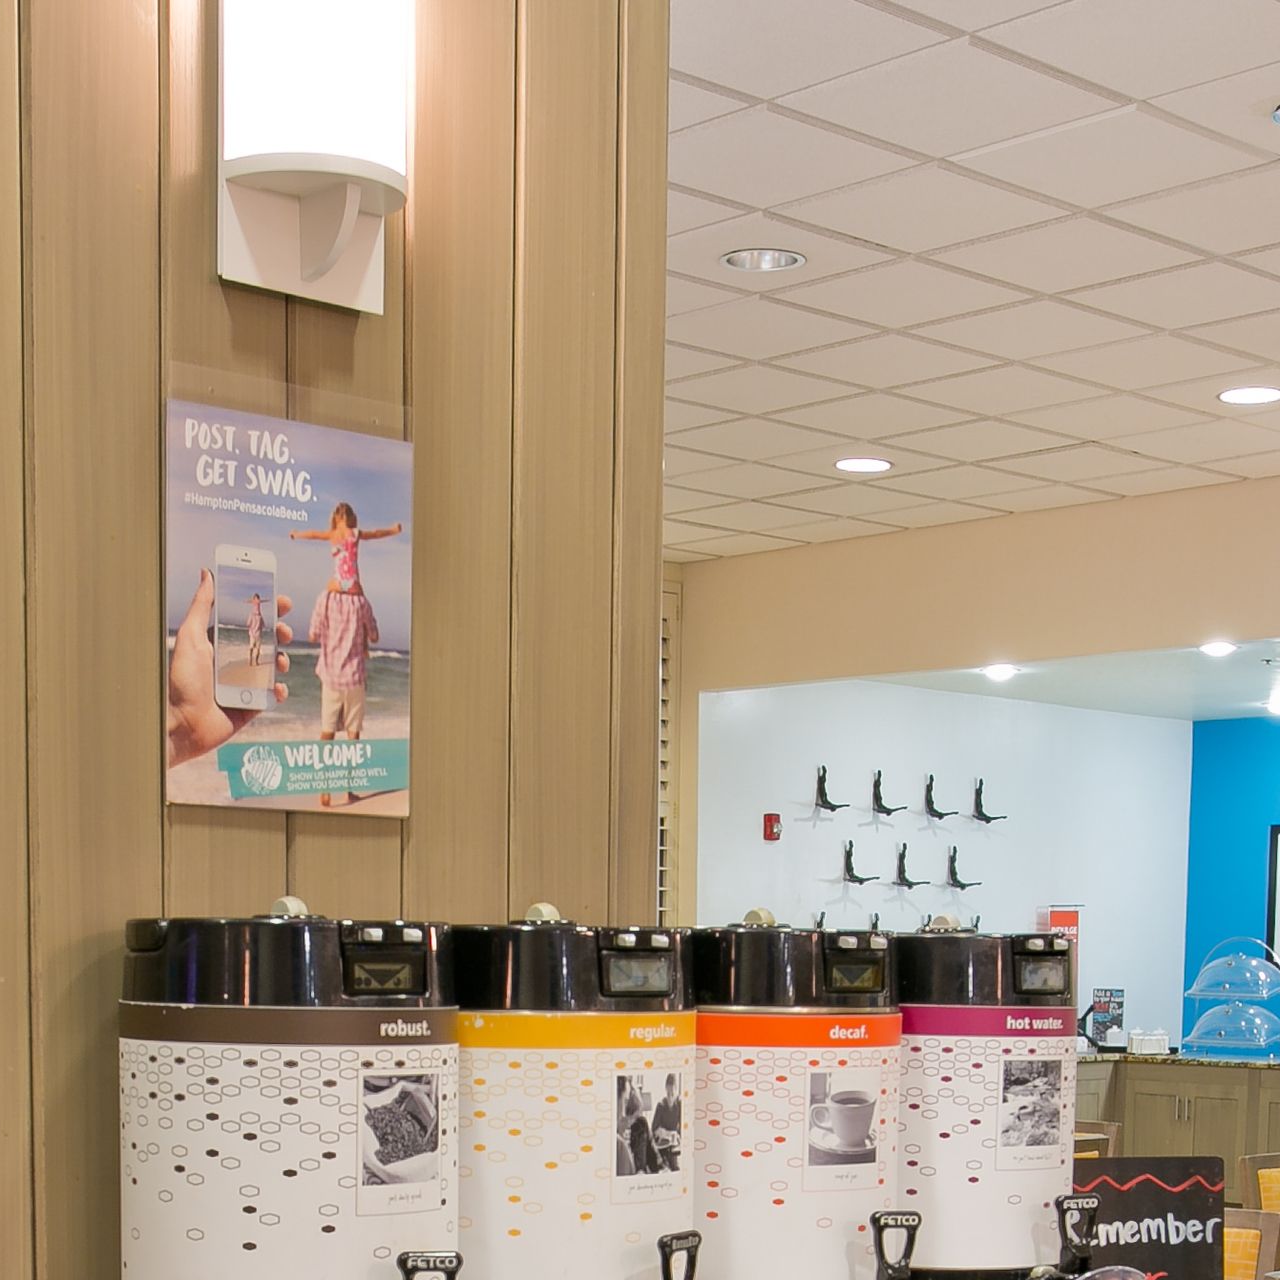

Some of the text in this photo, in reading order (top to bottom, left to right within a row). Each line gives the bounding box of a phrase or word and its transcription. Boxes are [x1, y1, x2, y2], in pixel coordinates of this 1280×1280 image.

[185, 418, 295, 465] POST. TAG.
[196, 454, 318, 502] GET SWAG.
[184, 492, 308, 522] #HamptonPensacolaBeach
[284, 743, 371, 770] WELCOME!
[289, 772, 312, 782] SHOW
[351, 768, 366, 777] AND
[287, 782, 311, 791] SHOW
[312, 781, 327, 790] YOU
[380, 1018, 431, 1037] robust.
[1006, 1015, 1064, 1030] hot water.
[630, 1024, 677, 1042] regular.
[830, 1025, 868, 1040] decaf.
[1063, 1198, 1099, 1209] FETCO
[880, 1215, 919, 1226] FETCO
[407, 1257, 458, 1270] FETCO
